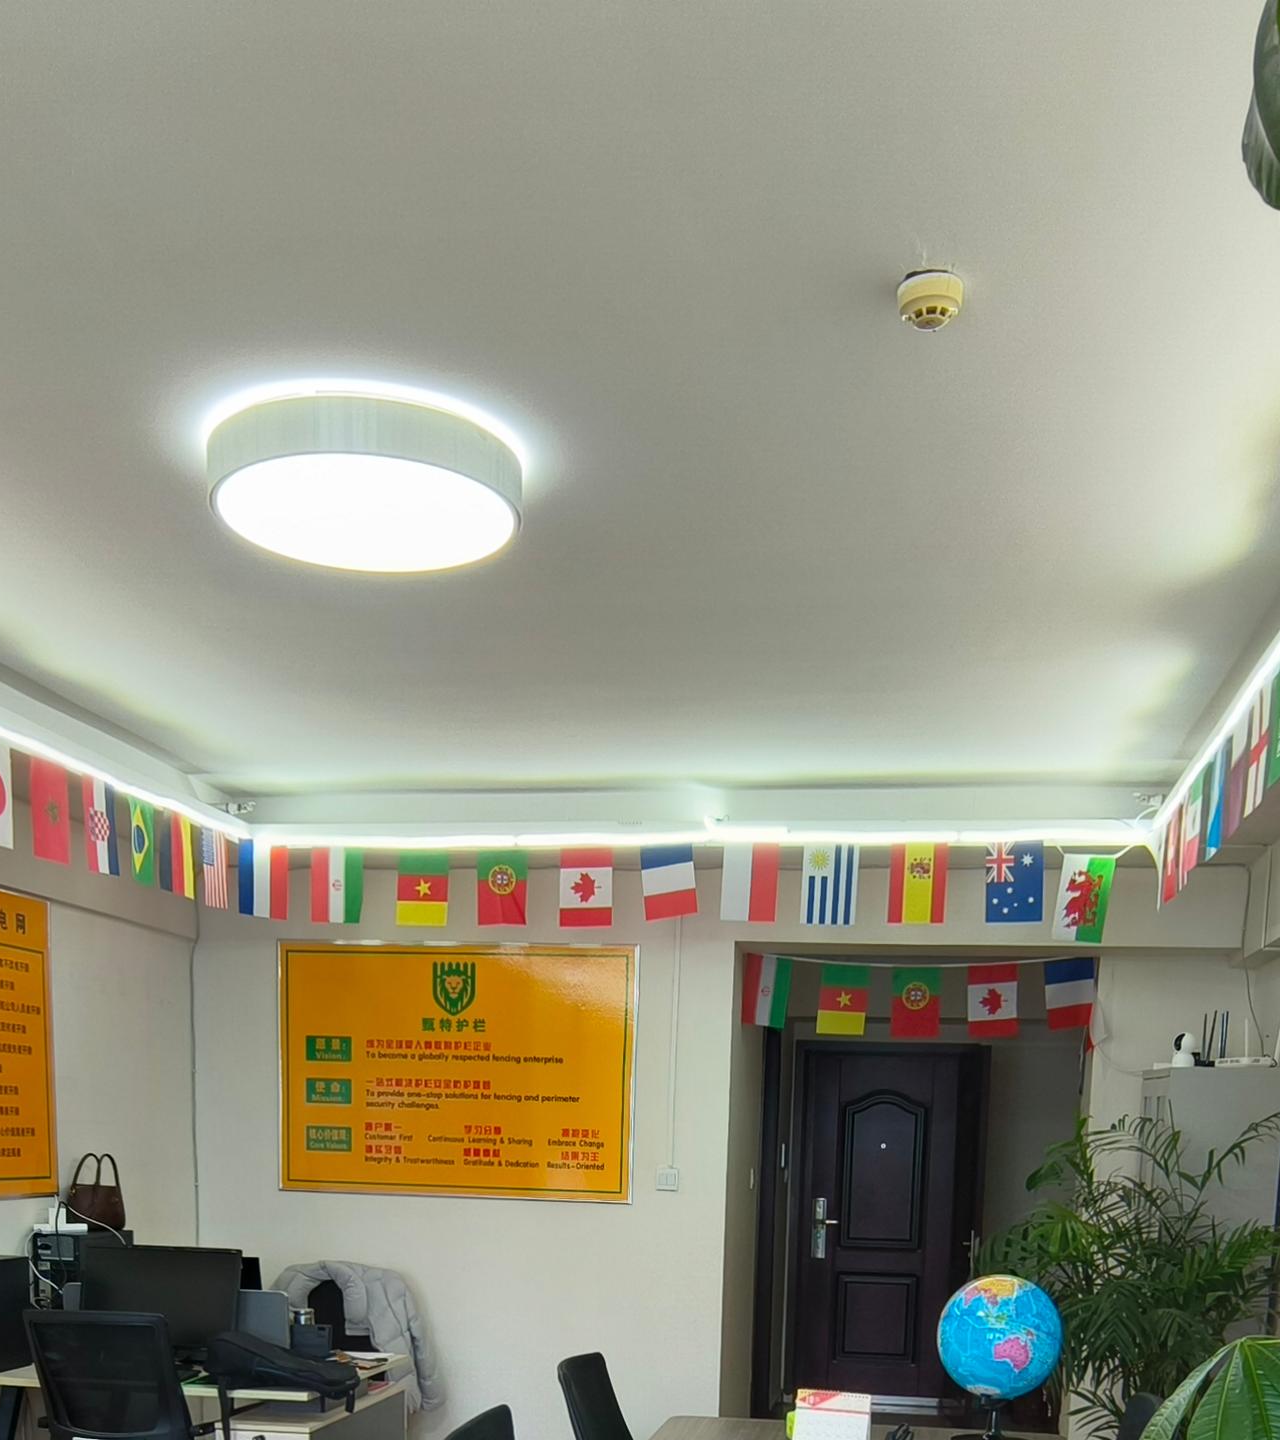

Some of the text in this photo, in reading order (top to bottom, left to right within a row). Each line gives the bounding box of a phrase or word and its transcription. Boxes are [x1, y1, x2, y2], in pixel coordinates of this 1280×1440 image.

[366, 1051, 376, 1060] To
[378, 1051, 408, 1060] become
[418, 1052, 449, 1063] globally
[451, 1053, 490, 1064] respected
[492, 1054, 521, 1065] fencing
[523, 1056, 564, 1065] enterprise
[366, 1089, 580, 1105] To provide one-stop solutions for fencing and perimeter
[365, 1101, 396, 1110] security
[365, 1132, 414, 1142] Customer First
[427, 1134, 465, 1144] Continuous
[468, 1136, 497, 1147] Learning
[508, 1138, 533, 1148] Sharing
[548, 1138, 605, 1150] Embrace Change
[365, 1155, 393, 1166] Integrity
[403, 1157, 455, 1166] Trustworthiness
[463, 1158, 540, 1169] Gratitude & Dedication
